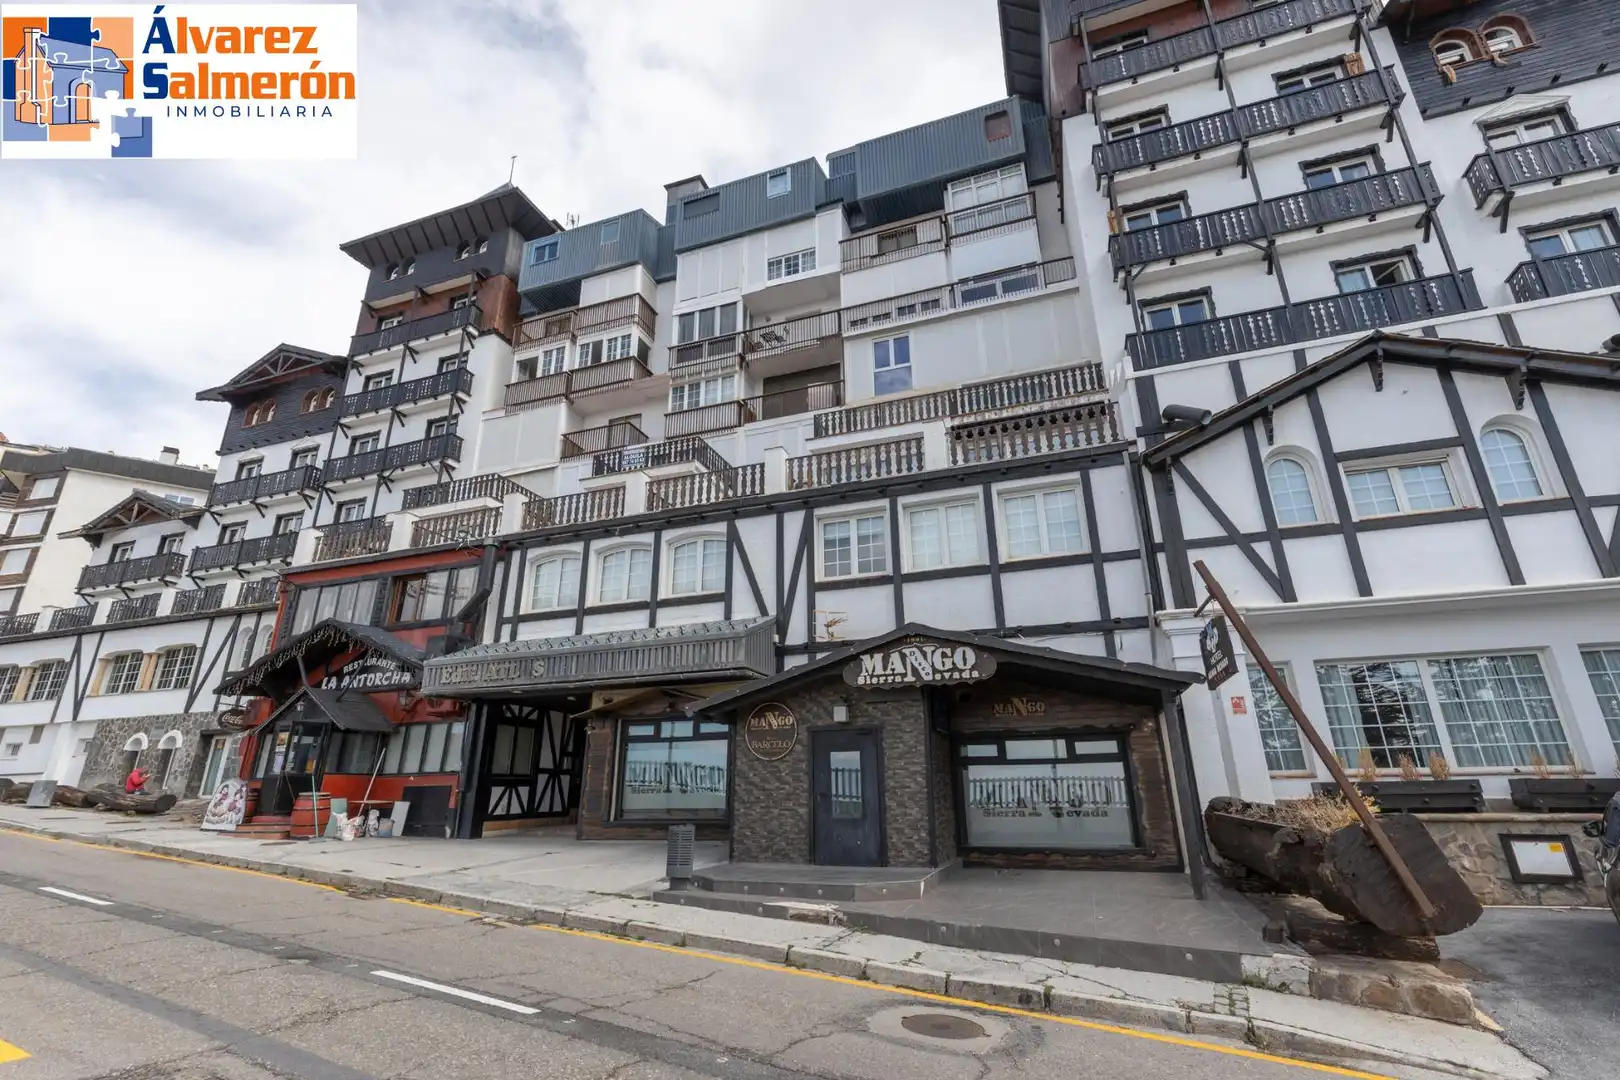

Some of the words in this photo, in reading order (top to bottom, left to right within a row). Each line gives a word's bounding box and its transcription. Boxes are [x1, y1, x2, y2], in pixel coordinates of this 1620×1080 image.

[343, 657, 396, 674] RESTURANTE
[860, 646, 976, 682] MANGO
[321, 675, 337, 690] LA
[341, 671, 411, 689] ANTORCHA
[857, 674, 902, 685] Sierra
[750, 711, 793, 729] MANGO
